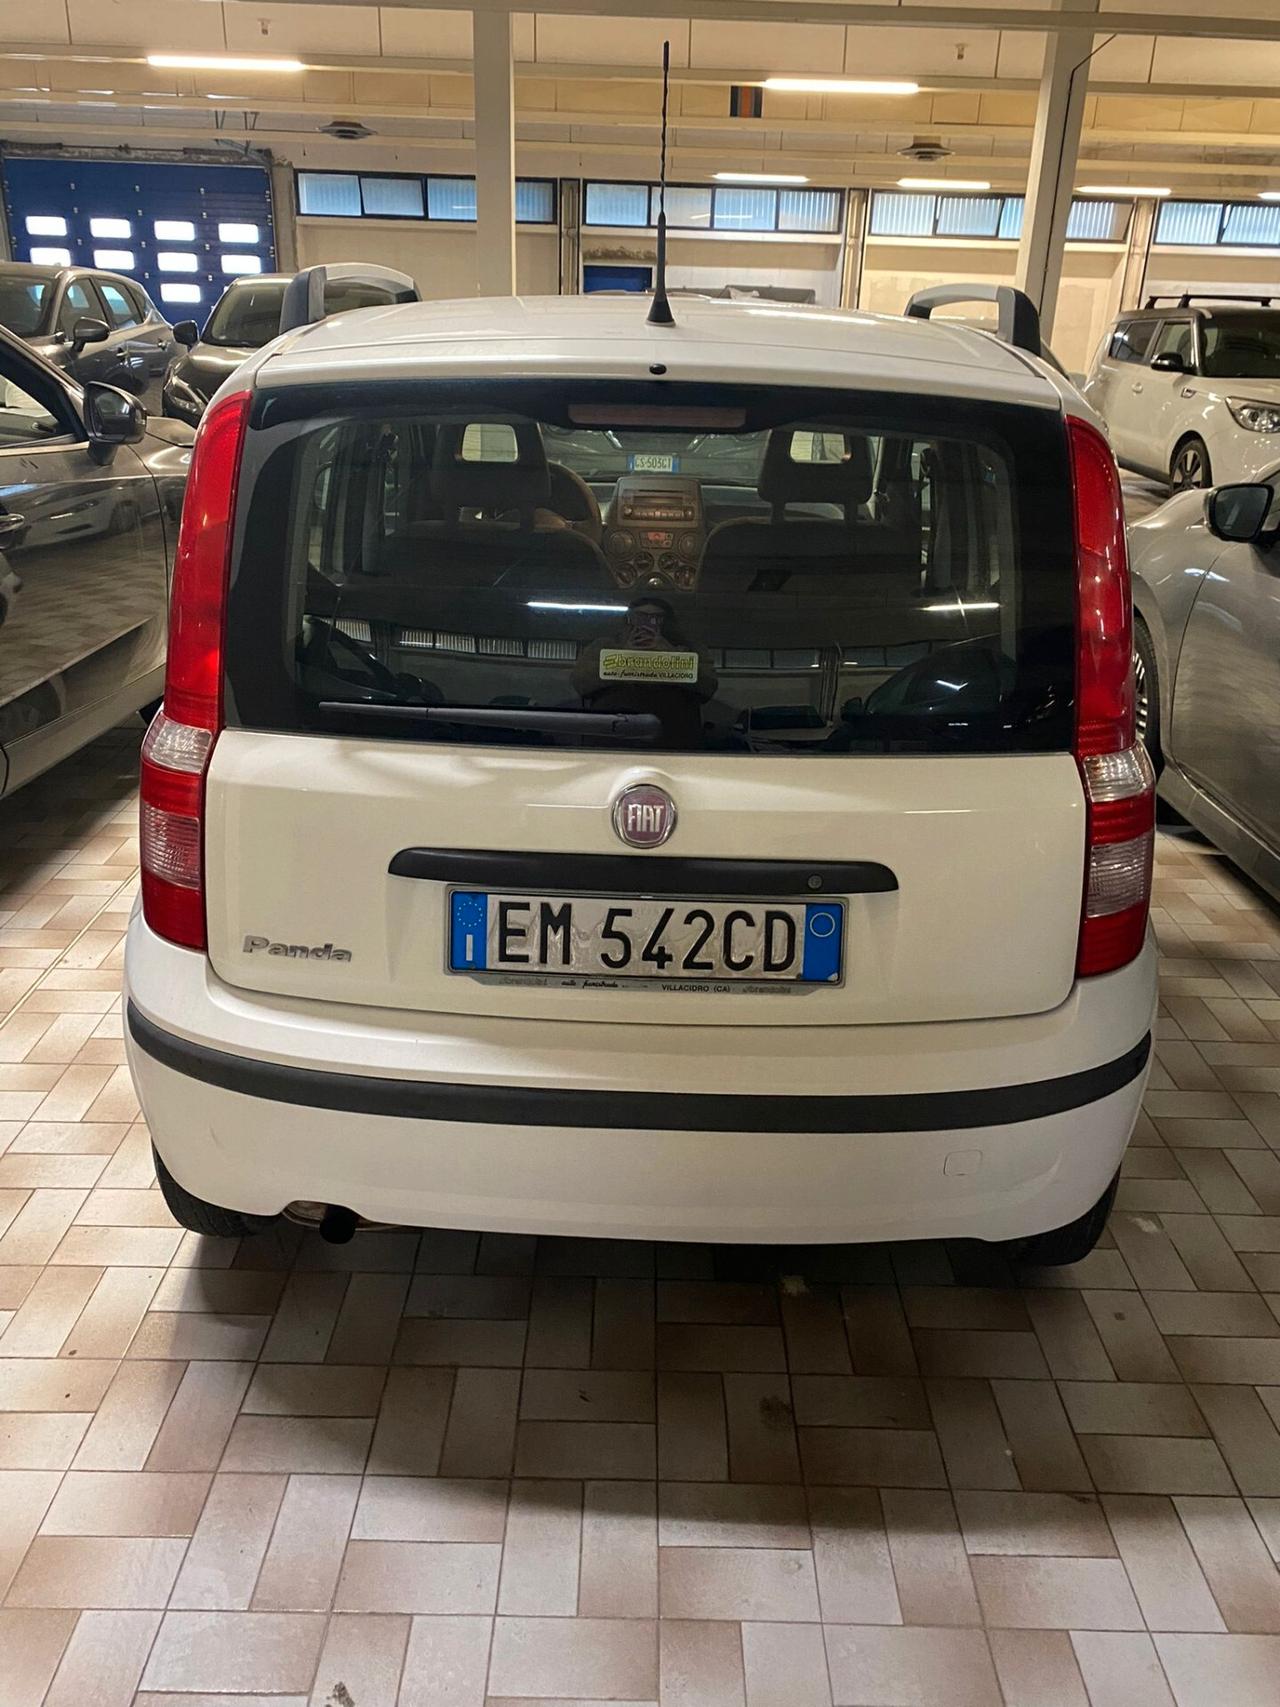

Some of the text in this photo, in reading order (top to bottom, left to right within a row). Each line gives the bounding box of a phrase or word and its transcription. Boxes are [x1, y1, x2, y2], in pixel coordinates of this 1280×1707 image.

[627, 803, 665, 832] FIAT
[243, 934, 352, 962] Panda
[499, 901, 797, 972] EM 542CD
[661, 983, 709, 993] VILLACIDRO
[713, 985, 731, 993] (CA)
